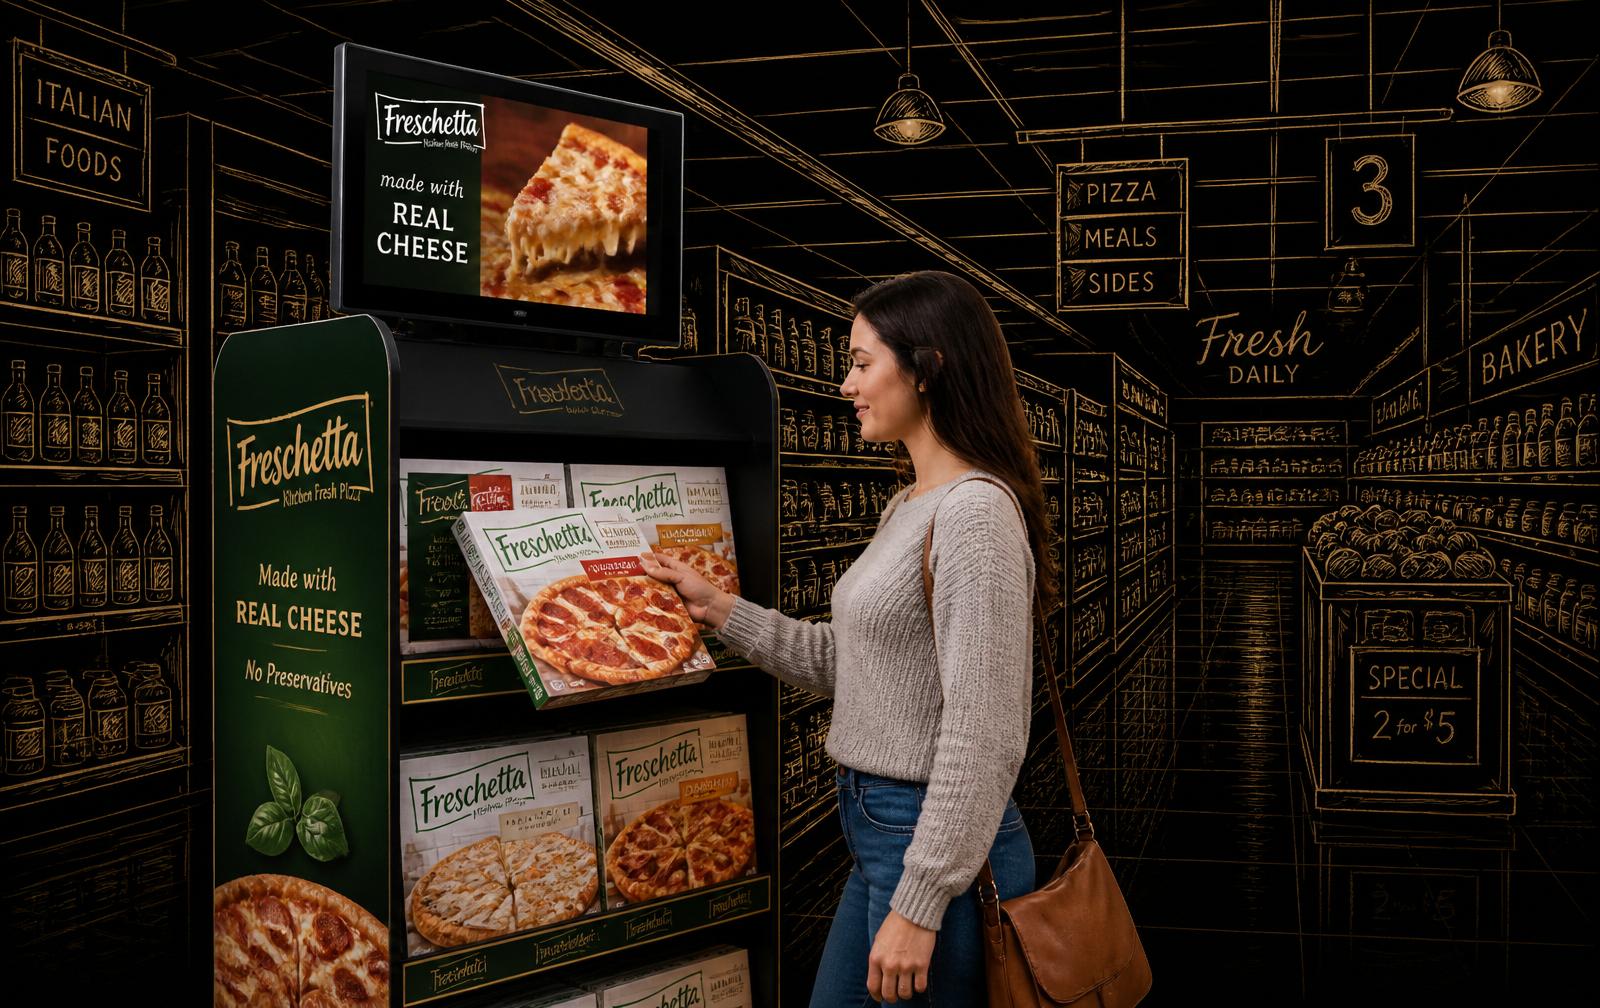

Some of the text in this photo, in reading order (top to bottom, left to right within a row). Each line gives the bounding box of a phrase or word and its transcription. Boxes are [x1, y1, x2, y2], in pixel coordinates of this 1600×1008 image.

[36, 79, 132, 132] ITALIAN
[384, 104, 481, 137] Freschetta
[45, 137, 122, 183] FOODS
[380, 173, 464, 199] made with
[1087, 180, 1157, 205] PIZZA
[1351, 154, 1393, 226] 3
[392, 201, 455, 232] REAL
[376, 231, 469, 264] CHEESE
[1085, 226, 1157, 249] MEALS
[1089, 271, 1154, 294] SIDES
[1195, 309, 1325, 366] Fresh
[1482, 307, 1588, 386] BAKERY
[1228, 364, 1300, 384] DAILY
[236, 415, 364, 498] Freschetta
[258, 563, 337, 592] Made with
[236, 600, 363, 638] REAL CHEESE
[245, 659, 352, 699] No Preservatives
[1368, 664, 1464, 690] SPECIAL
[1372, 708, 1456, 745] 2 for $5
[614, 739, 698, 792] Freschetta
[420, 763, 528, 824] Freschetta
